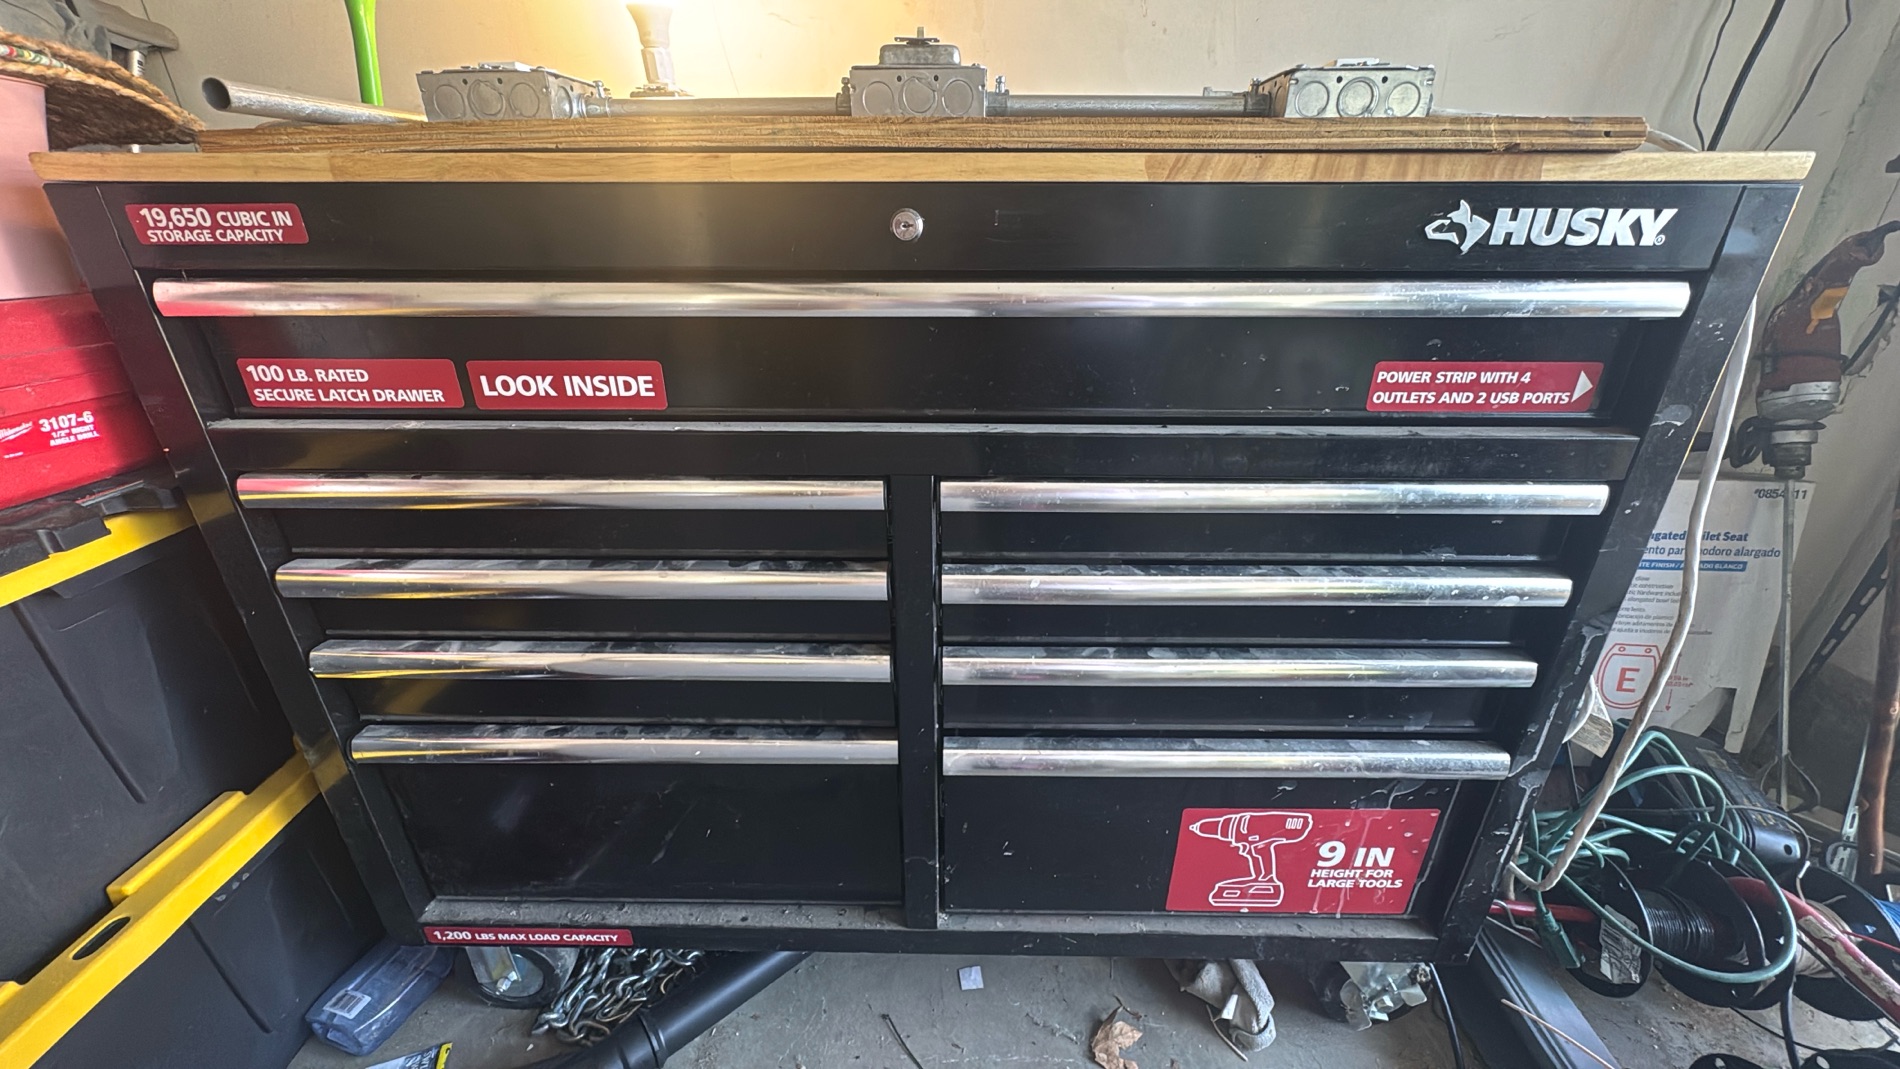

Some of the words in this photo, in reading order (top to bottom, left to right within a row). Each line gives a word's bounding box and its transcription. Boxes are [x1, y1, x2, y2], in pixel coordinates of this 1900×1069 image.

[139, 207, 211, 230] 19,650
[216, 211, 270, 227] CUBIC
[272, 211, 293, 227] IN
[1489, 208, 1678, 246] HUSKY
[147, 229, 214, 242] STORAGE
[215, 229, 283, 242] CAPACITY
[245, 365, 284, 382] 100
[287, 369, 313, 382] LB.
[315, 369, 369, 382] RATED
[1376, 371, 1431, 384] POWER
[1435, 371, 1477, 384] STRIP
[1479, 371, 1518, 384] WITH
[1520, 371, 1532, 384] 4
[479, 374, 557, 397] LOOK
[565, 374, 656, 397] INSIDE
[253, 388, 316, 402] SECURE
[318, 389, 370, 402] LATCH
[372, 389, 445, 402] DRAWER
[1372, 392, 1436, 404] OUTLETS
[1438, 392, 1474, 404] AND
[1476, 392, 1486, 404] 2
[1489, 392, 1519, 404] USB
[1522, 392, 1570, 405] PORTS
[38, 410, 94, 432] 3107-6
[49, 435, 76, 447] ANGLE
[76, 430, 100, 441] DRILL
[1651, 530, 1687, 542] gated
[1723, 531, 1749, 541] Seat
[1667, 547, 1685, 557] par
[1734, 547, 1781, 559] alargado
[1616, 667, 1640, 693] E
[1316, 840, 1346, 867] 9
[1353, 847, 1395, 867] IN
[1310, 869, 1362, 878] HEIGHT
[1365, 869, 1394, 878] FOR
[1307, 879, 1355, 888] LARGE
[1358, 879, 1403, 888] TOOLS
[433, 930, 471, 941] 1,200
[475, 933, 496, 941] LBS
[498, 933, 526, 941] MAX
[563, 934, 618, 942] CAPACITY
